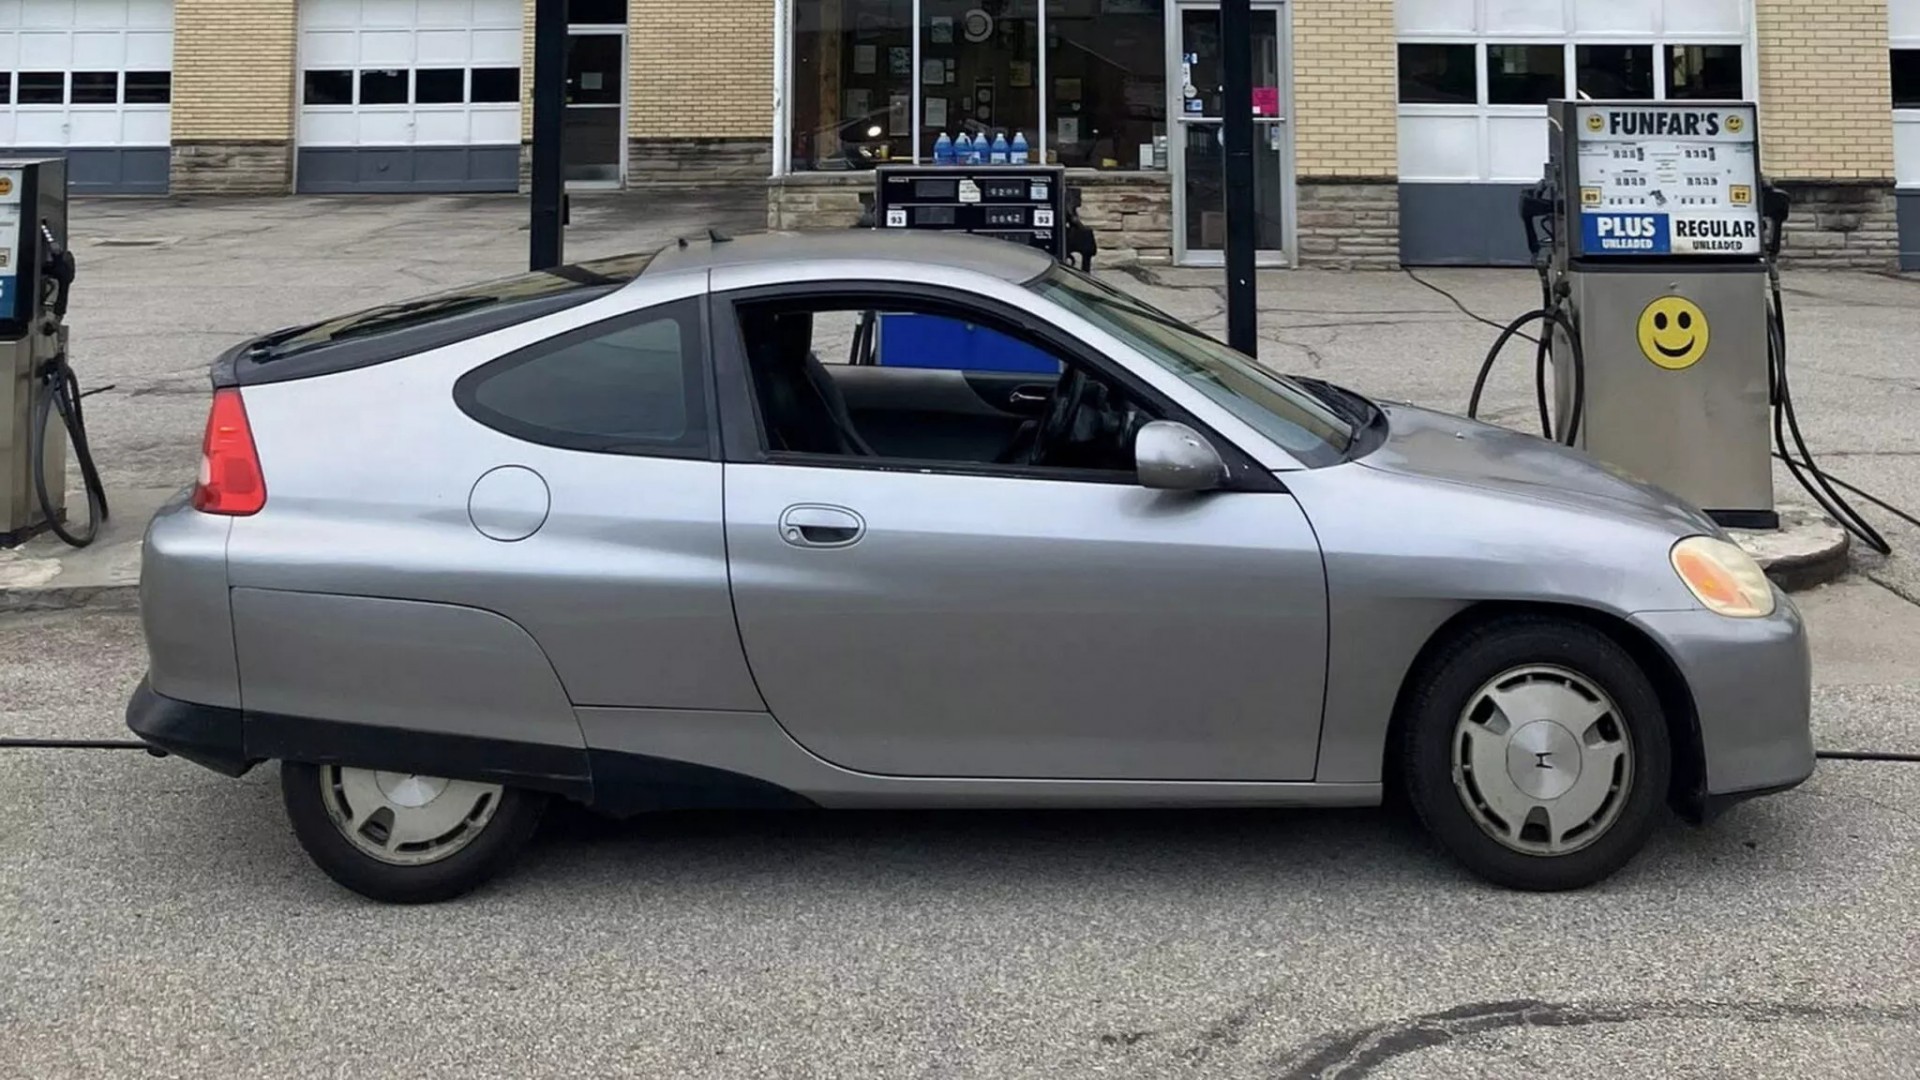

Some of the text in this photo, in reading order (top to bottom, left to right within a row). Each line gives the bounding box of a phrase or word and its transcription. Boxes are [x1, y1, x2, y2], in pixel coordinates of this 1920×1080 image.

[1609, 111, 1719, 136] FUNFAR'S
[890, 215, 903, 224] 93
[1037, 215, 1050, 225] 93
[1597, 216, 1656, 237] PLUS
[1676, 220, 1757, 238] REGULAR
[1602, 238, 1654, 249] UNLEADED
[1692, 240, 1743, 250] UNLEADED
